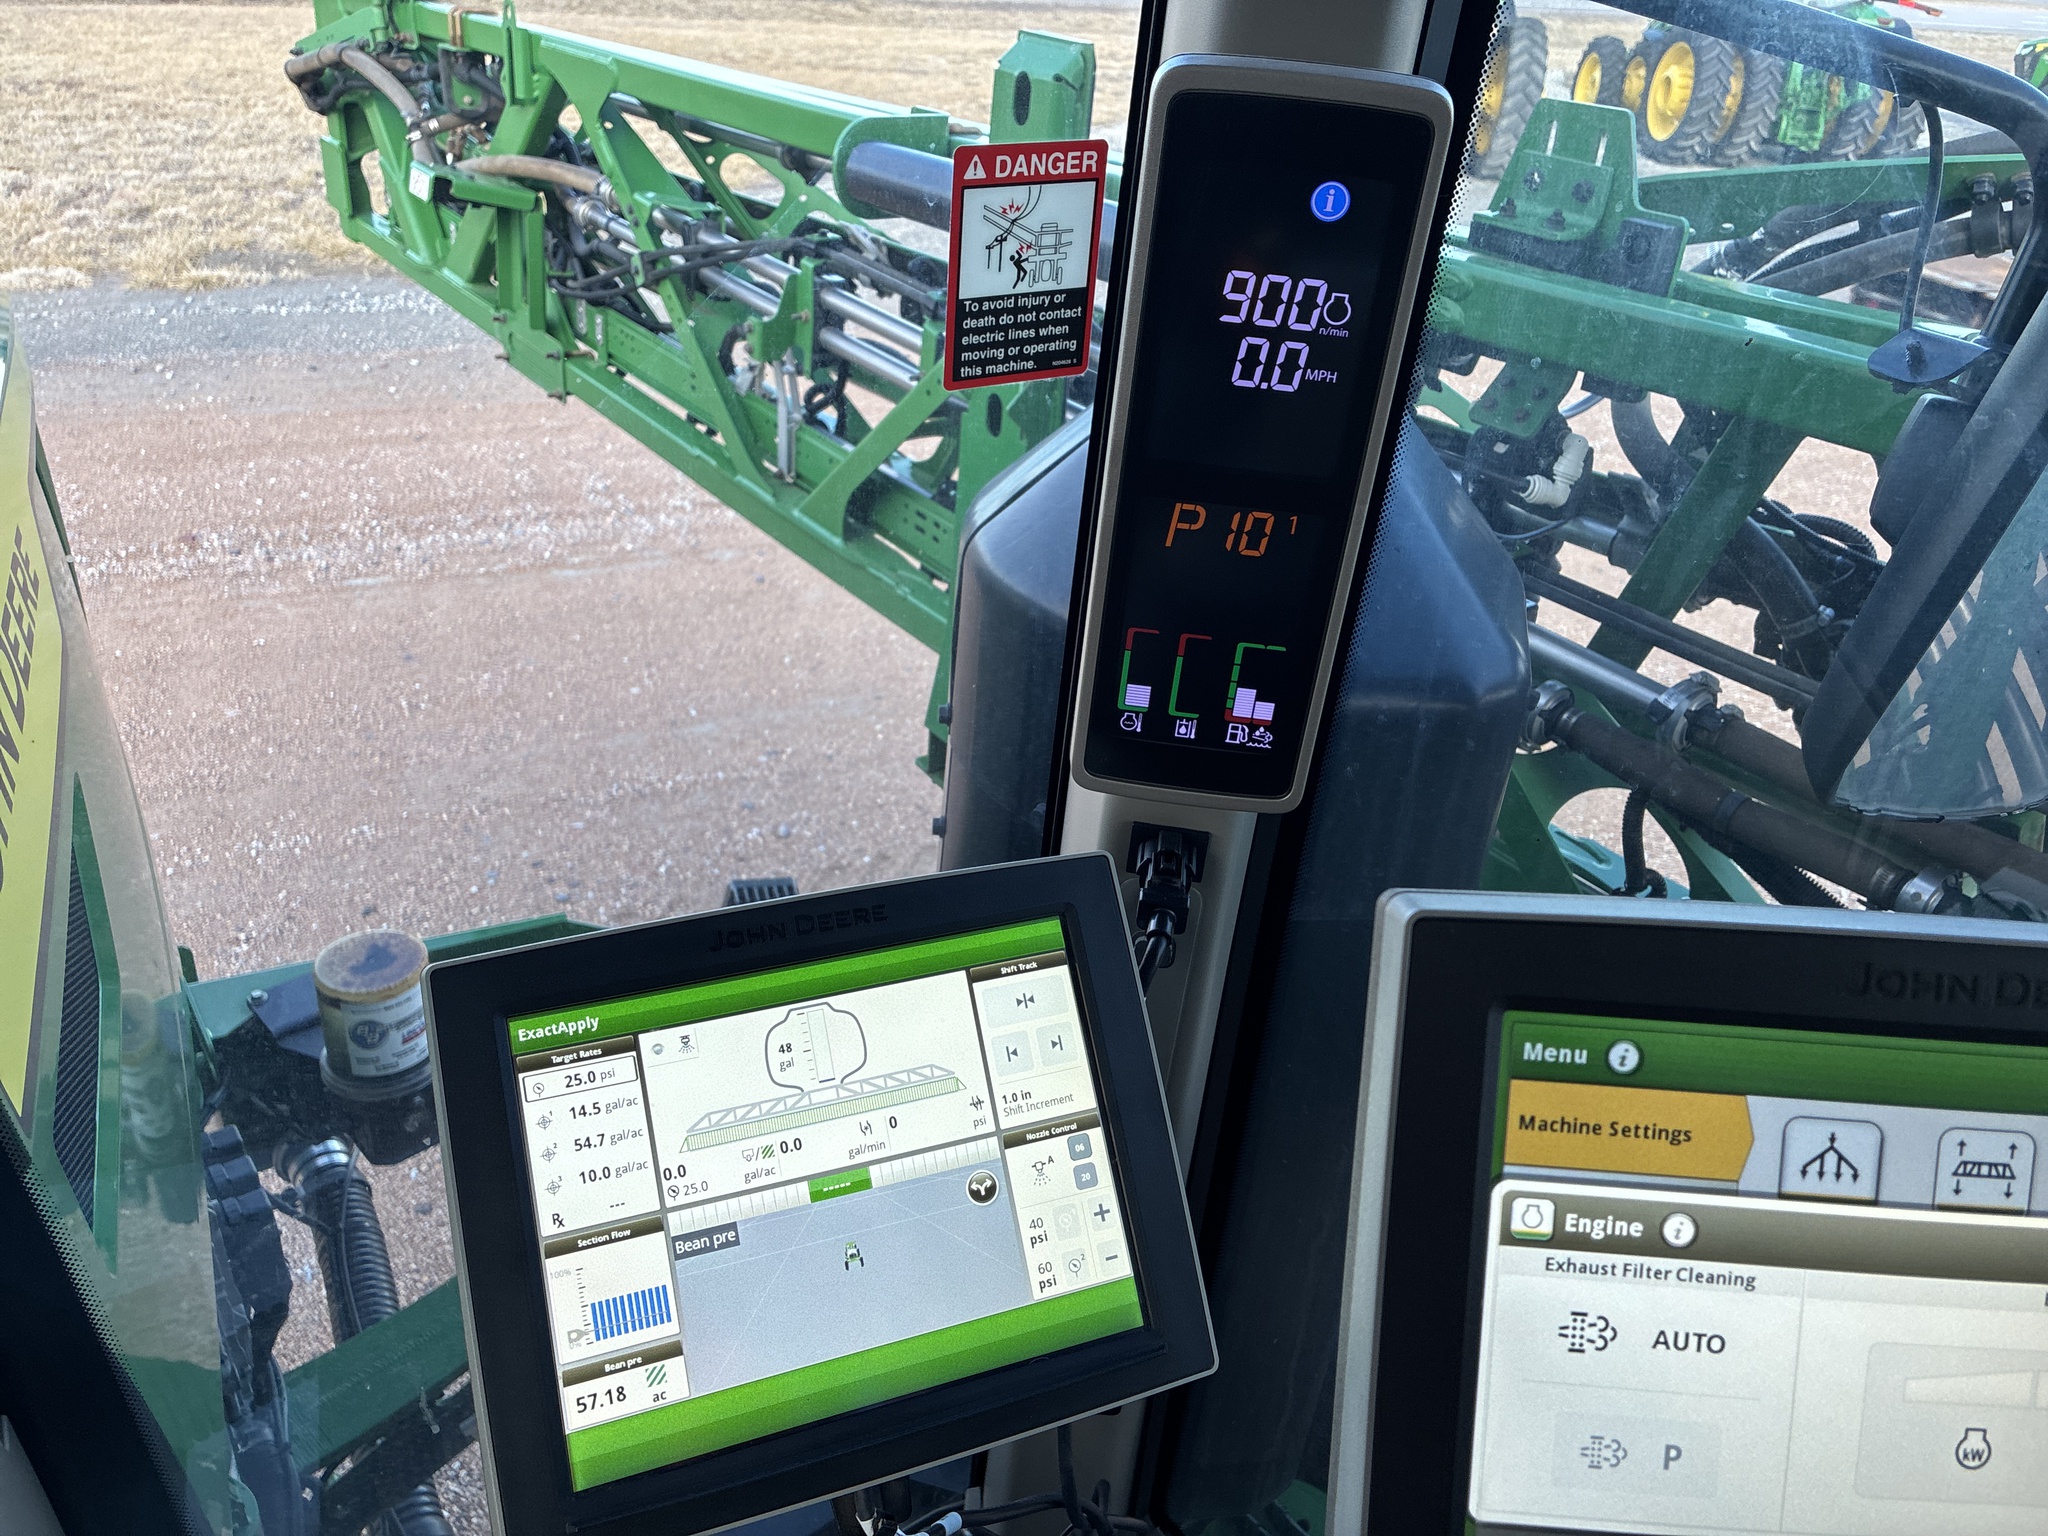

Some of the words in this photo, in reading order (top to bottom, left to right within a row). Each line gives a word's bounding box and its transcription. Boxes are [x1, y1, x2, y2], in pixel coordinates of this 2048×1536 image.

[995, 151, 1098, 178] DANGER
[964, 301, 979, 313] To
[982, 297, 1015, 311] avoid
[1018, 294, 1051, 309] injury
[1054, 292, 1066, 303] or
[1219, 270, 1328, 332] 900
[962, 315, 996, 329] death
[999, 312, 1014, 325] do
[1017, 310, 1037, 322] not
[1039, 306, 1082, 321] contact
[961, 329, 1005, 345] electric
[1008, 327, 1036, 341] lines
[1039, 324, 1069, 337] when
[1319, 325, 1349, 338] n/min
[961, 346, 1004, 362] moving
[1008, 346, 1020, 357] or
[1023, 339, 1077, 356] operating
[960, 363, 982, 377] this
[985, 359, 1037, 375] machine.
[1231, 337, 1309, 392] 0.0
[1305, 367, 1338, 384] MPH
[1165, 502, 1206, 547] P
[1224, 511, 1274, 558] 10
[709, 922, 787, 952] JOHN
[794, 904, 888, 935] DEERE
[1000, 963, 1018, 975] Shift
[1018, 960, 1038, 972] Track
[1860, 962, 1979, 1003] JOHN
[517, 1015, 600, 1042] ExactApply
[551, 1052, 577, 1064] Target
[579, 1047, 602, 1060] Rates
[778, 1042, 793, 1054] 48
[1522, 1041, 1588, 1065] Menu
[779, 1057, 795, 1072] gal
[564, 1071, 597, 1089] 25.0
[600, 1068, 616, 1083] psi
[1002, 1091, 1018, 1105] 1.0
[1020, 1090, 1032, 1101] in
[1003, 1105, 1025, 1117] Shift
[1026, 1093, 1074, 1112] Increment
[569, 1102, 602, 1120] 14.5
[605, 1095, 639, 1114] gal/ac
[888, 1116, 899, 1130] 0
[973, 1115, 988, 1131] psi
[1026, 1129, 1050, 1141] Nozzle
[1051, 1122, 1078, 1135] Control
[1518, 1114, 1602, 1136] Machine
[1609, 1121, 1693, 1146] Settings
[574, 1133, 606, 1152] 54.7
[609, 1127, 644, 1146] gal/ac
[780, 1137, 803, 1154] 0.0
[1074, 1142, 1085, 1152] 06
[848, 1140, 887, 1159] gal/min
[579, 1166, 612, 1184] 10.0
[614, 1159, 649, 1178] gal/ac
[663, 1164, 687, 1182] 0.0
[743, 1165, 777, 1184] gal/ac
[1081, 1172, 1091, 1182] 20
[683, 1180, 709, 1197] 25.0
[1029, 1217, 1044, 1230] 40
[1564, 1213, 1644, 1240] Engine
[577, 1235, 610, 1248] Section
[611, 1229, 631, 1240] Flow
[675, 1236, 710, 1254] Bean
[712, 1230, 737, 1248] pre
[1030, 1230, 1049, 1249] psi
[549, 1268, 572, 1280] 100%
[1038, 1261, 1053, 1275] 60
[1545, 1256, 1618, 1279] Exhaust
[1622, 1261, 1672, 1282] Filter
[1676, 1266, 1757, 1292] Cleaning
[1038, 1275, 1057, 1293] psi
[1652, 1330, 1727, 1354] AUTO
[604, 1359, 626, 1373] Bean
[626, 1355, 643, 1368] pre
[576, 1386, 627, 1414] 57.18
[652, 1390, 667, 1403] ac
[1663, 1444, 1683, 1470] P
